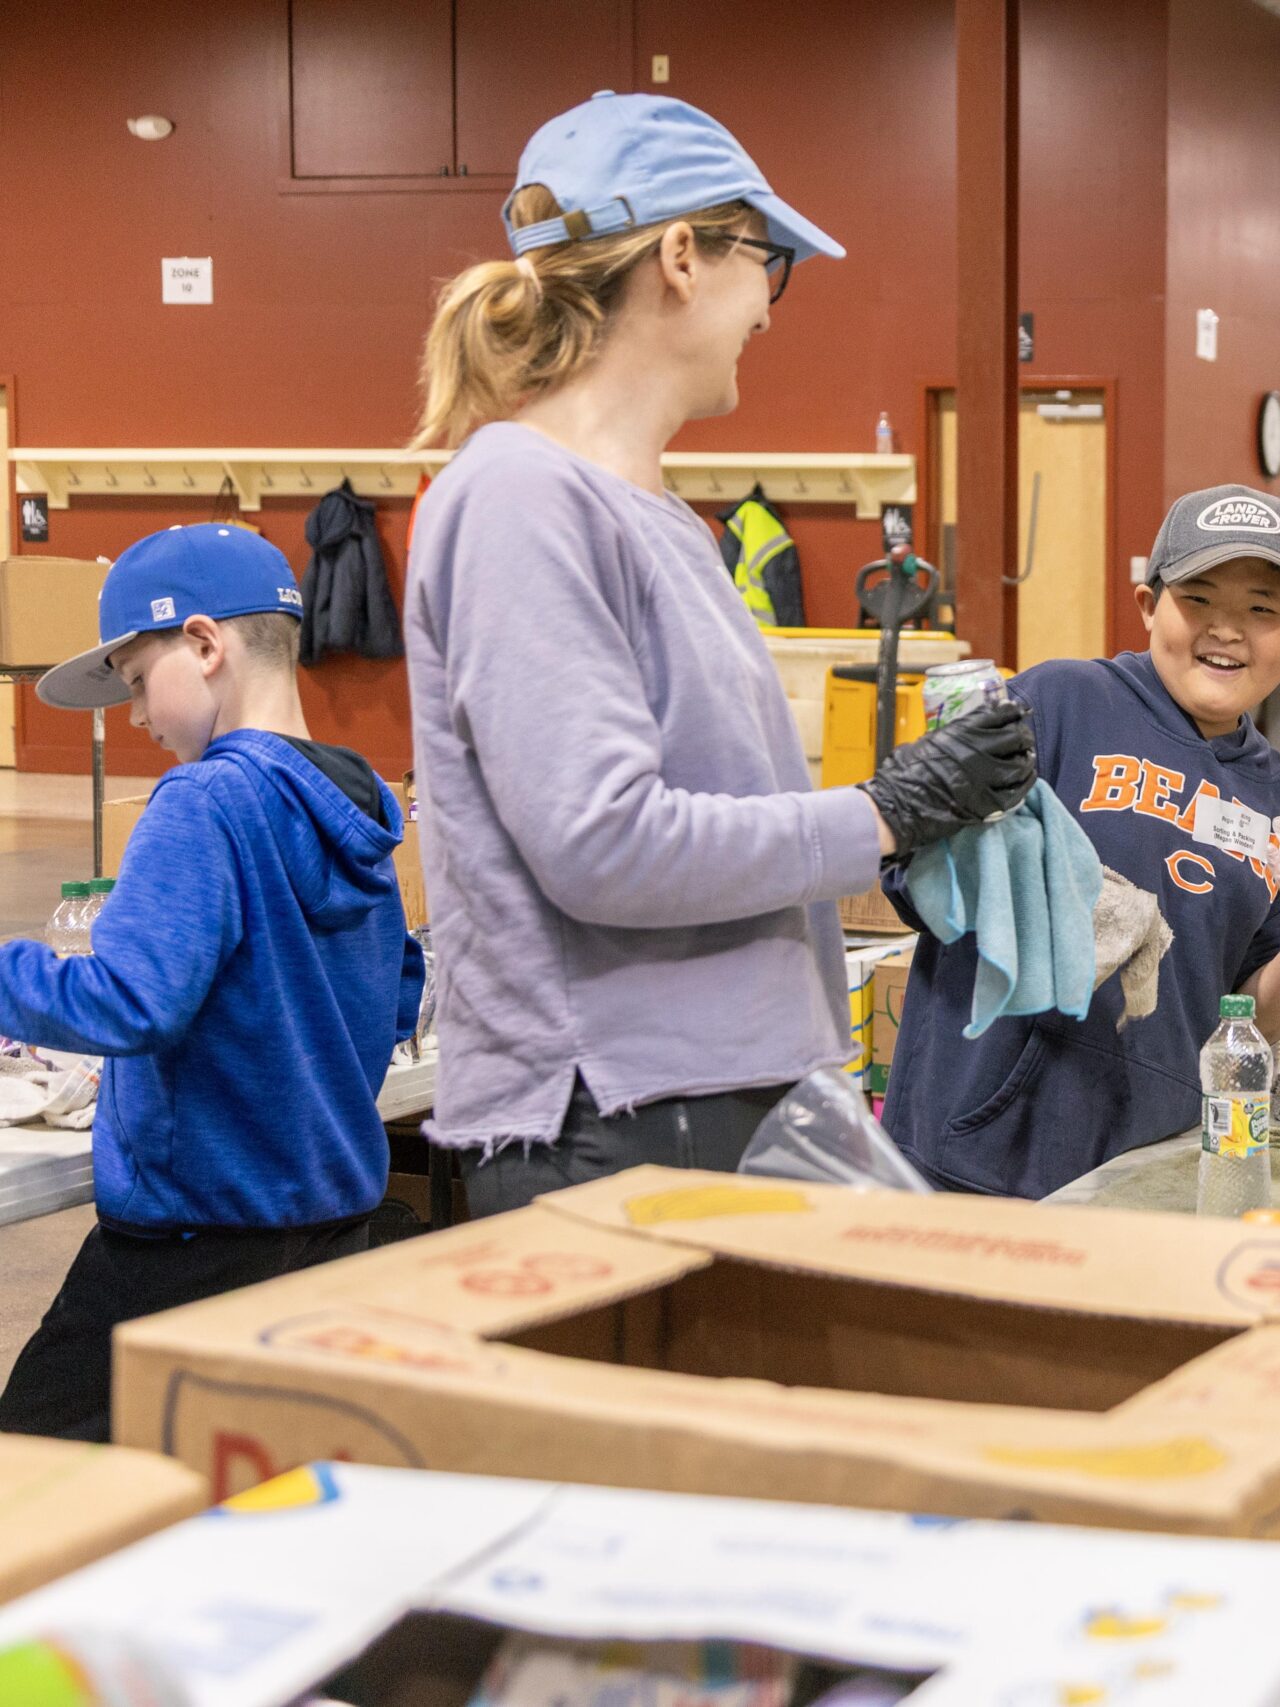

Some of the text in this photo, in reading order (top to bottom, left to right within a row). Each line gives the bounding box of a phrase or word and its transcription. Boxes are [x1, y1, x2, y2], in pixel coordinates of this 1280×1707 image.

[171, 268, 200, 278] ZONE
[1214, 503, 1258, 517] LAND
[1218, 513, 1272, 528] ROVER
